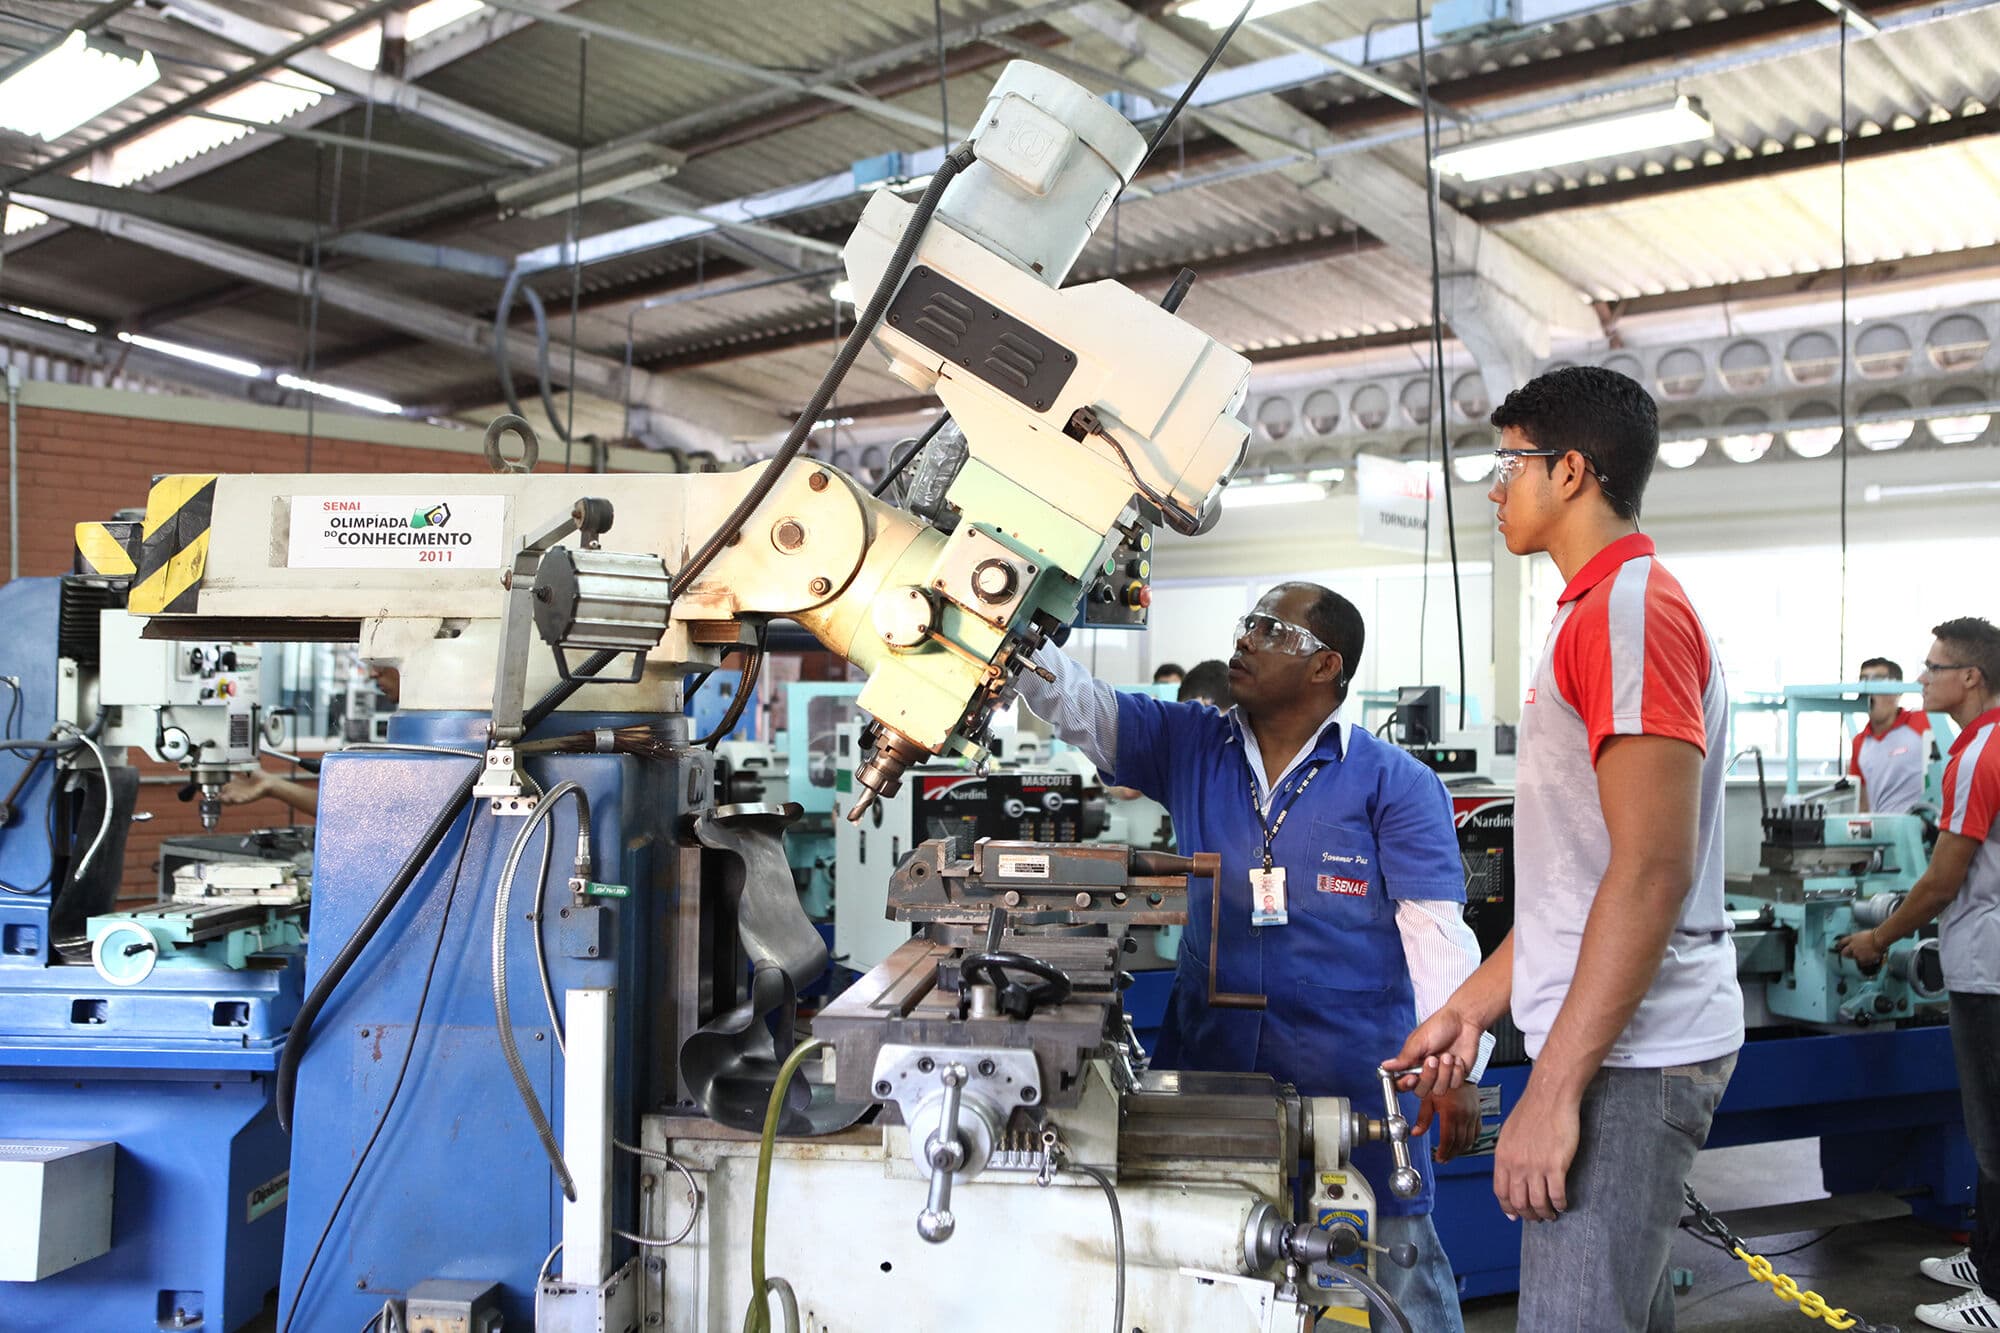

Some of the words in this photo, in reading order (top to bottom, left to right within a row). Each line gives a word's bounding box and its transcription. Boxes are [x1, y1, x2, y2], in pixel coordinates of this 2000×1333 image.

[323, 501, 361, 511] SENAI
[330, 514, 408, 528] OLIMPÍADA
[324, 530, 338, 538] DO
[338, 532, 472, 545] CONHECIMENTO
[419, 550, 452, 562] 2011
[1021, 775, 1072, 787] MASCOTE
[950, 787, 988, 800] Nardini
[1334, 879, 1364, 895] SENAI
